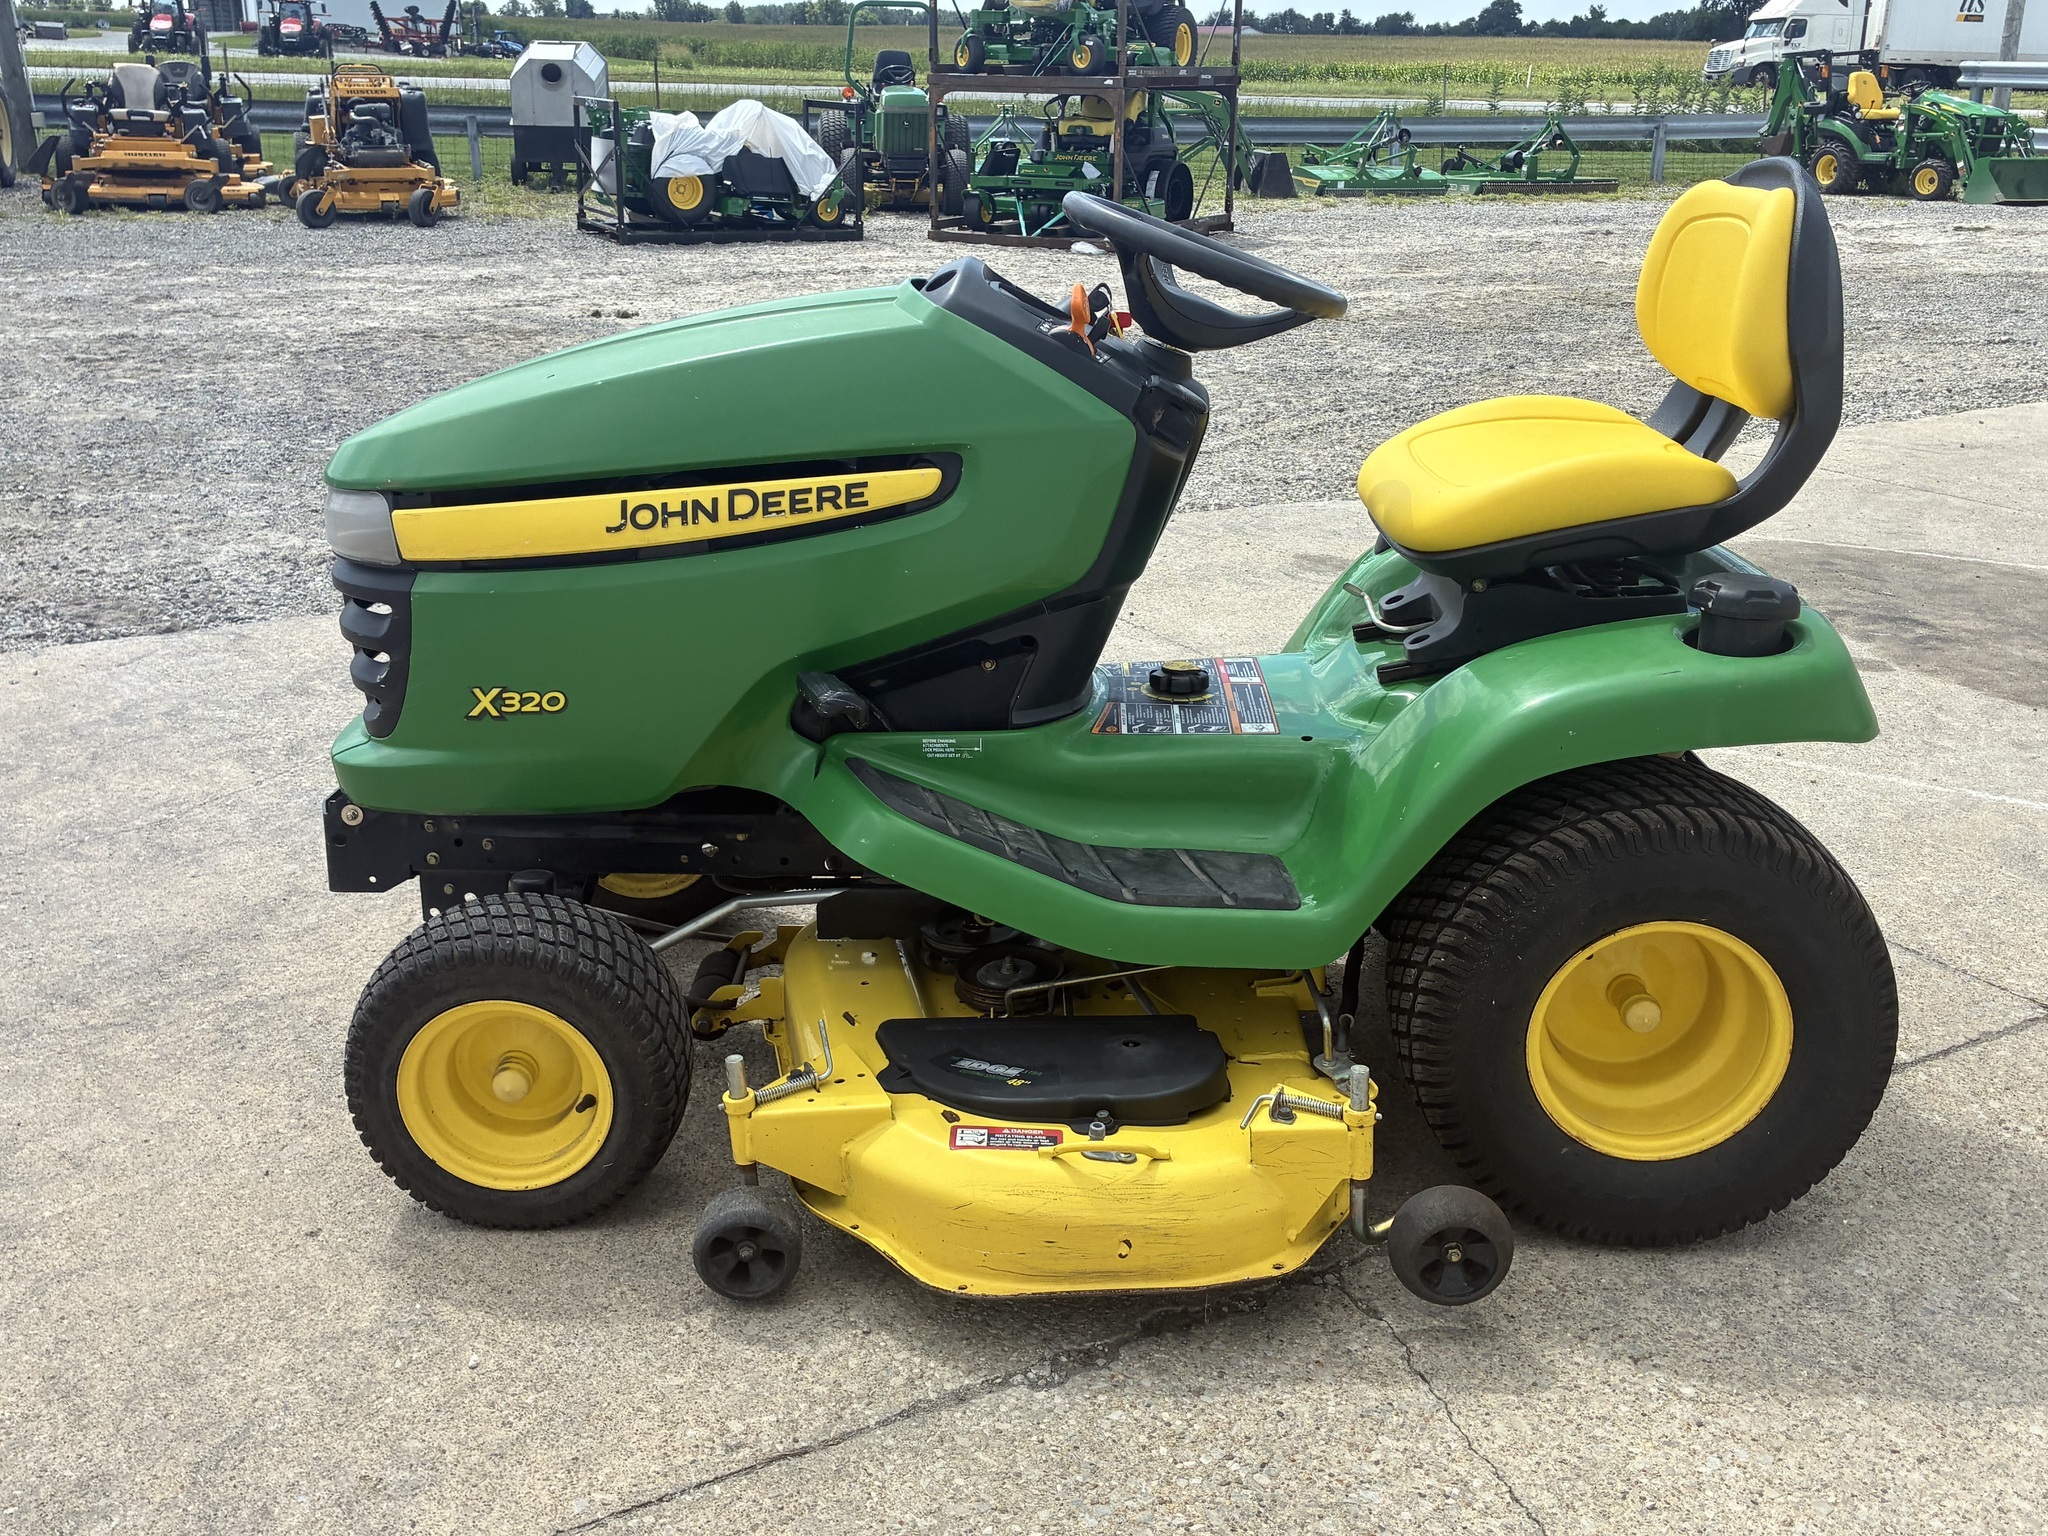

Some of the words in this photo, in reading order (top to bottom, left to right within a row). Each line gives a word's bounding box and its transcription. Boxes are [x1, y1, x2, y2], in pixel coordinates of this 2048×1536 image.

[1074, 154, 1098, 162] DEERE
[606, 497, 719, 533] JOHN
[728, 481, 869, 522] DEERE
[467, 687, 567, 718] X320
[951, 1057, 1025, 1077] EDGE
